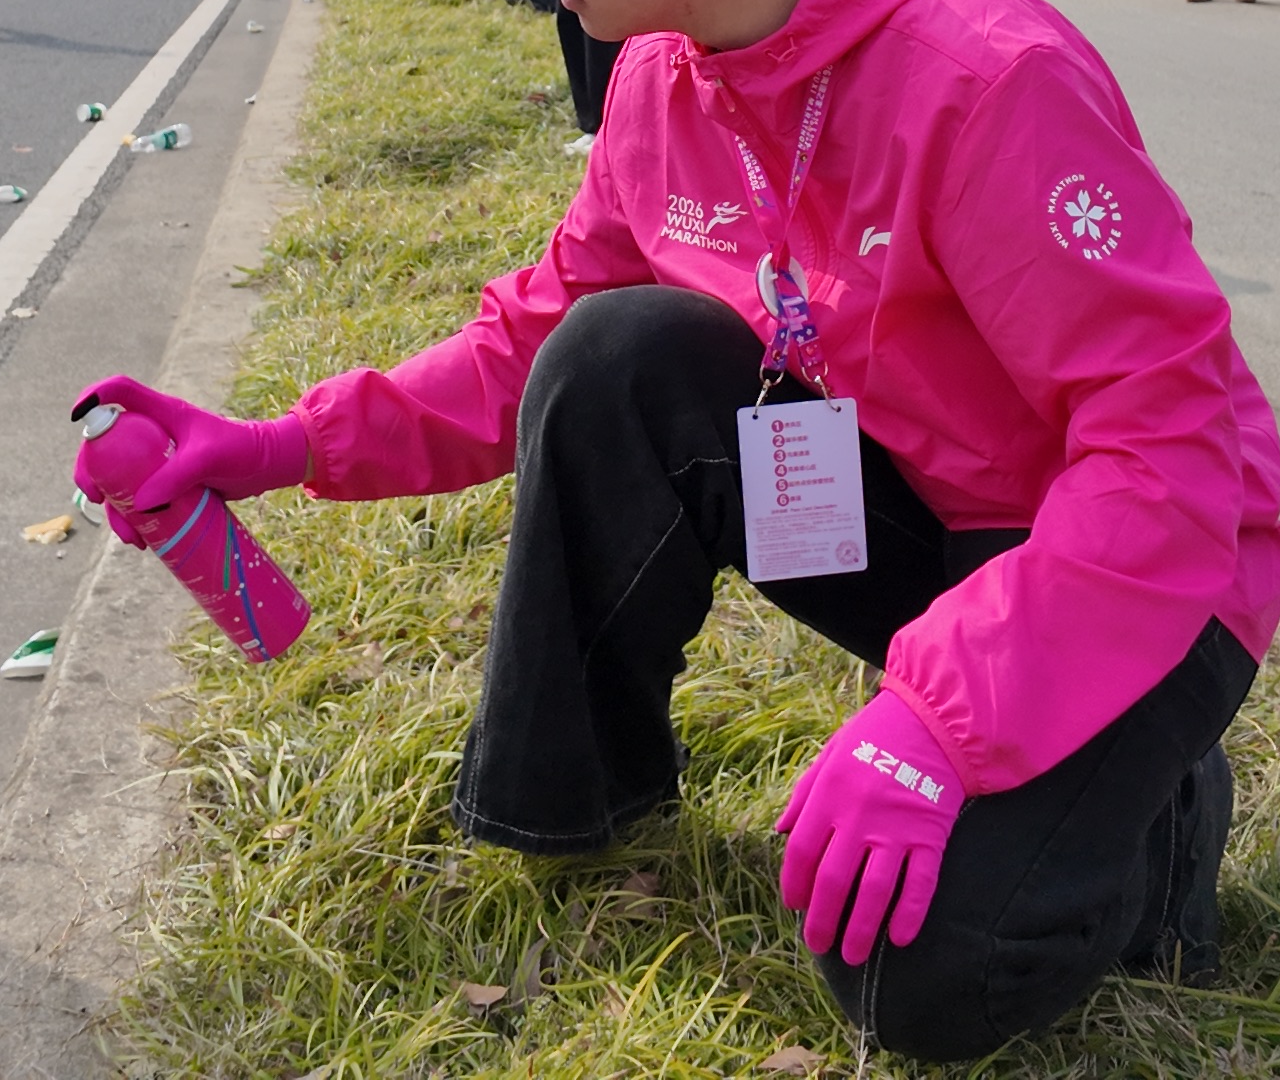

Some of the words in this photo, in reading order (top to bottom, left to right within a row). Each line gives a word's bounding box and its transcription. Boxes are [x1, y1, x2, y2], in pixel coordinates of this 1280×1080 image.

[668, 194, 704, 219] 2026
[1047, 174, 1085, 214] MARATHON
[666, 211, 705, 234] WUXI
[1048, 221, 1069, 249] WUXI
[660, 226, 738, 253] MARATHON
[851, 740, 945, 804] 海澜之家
